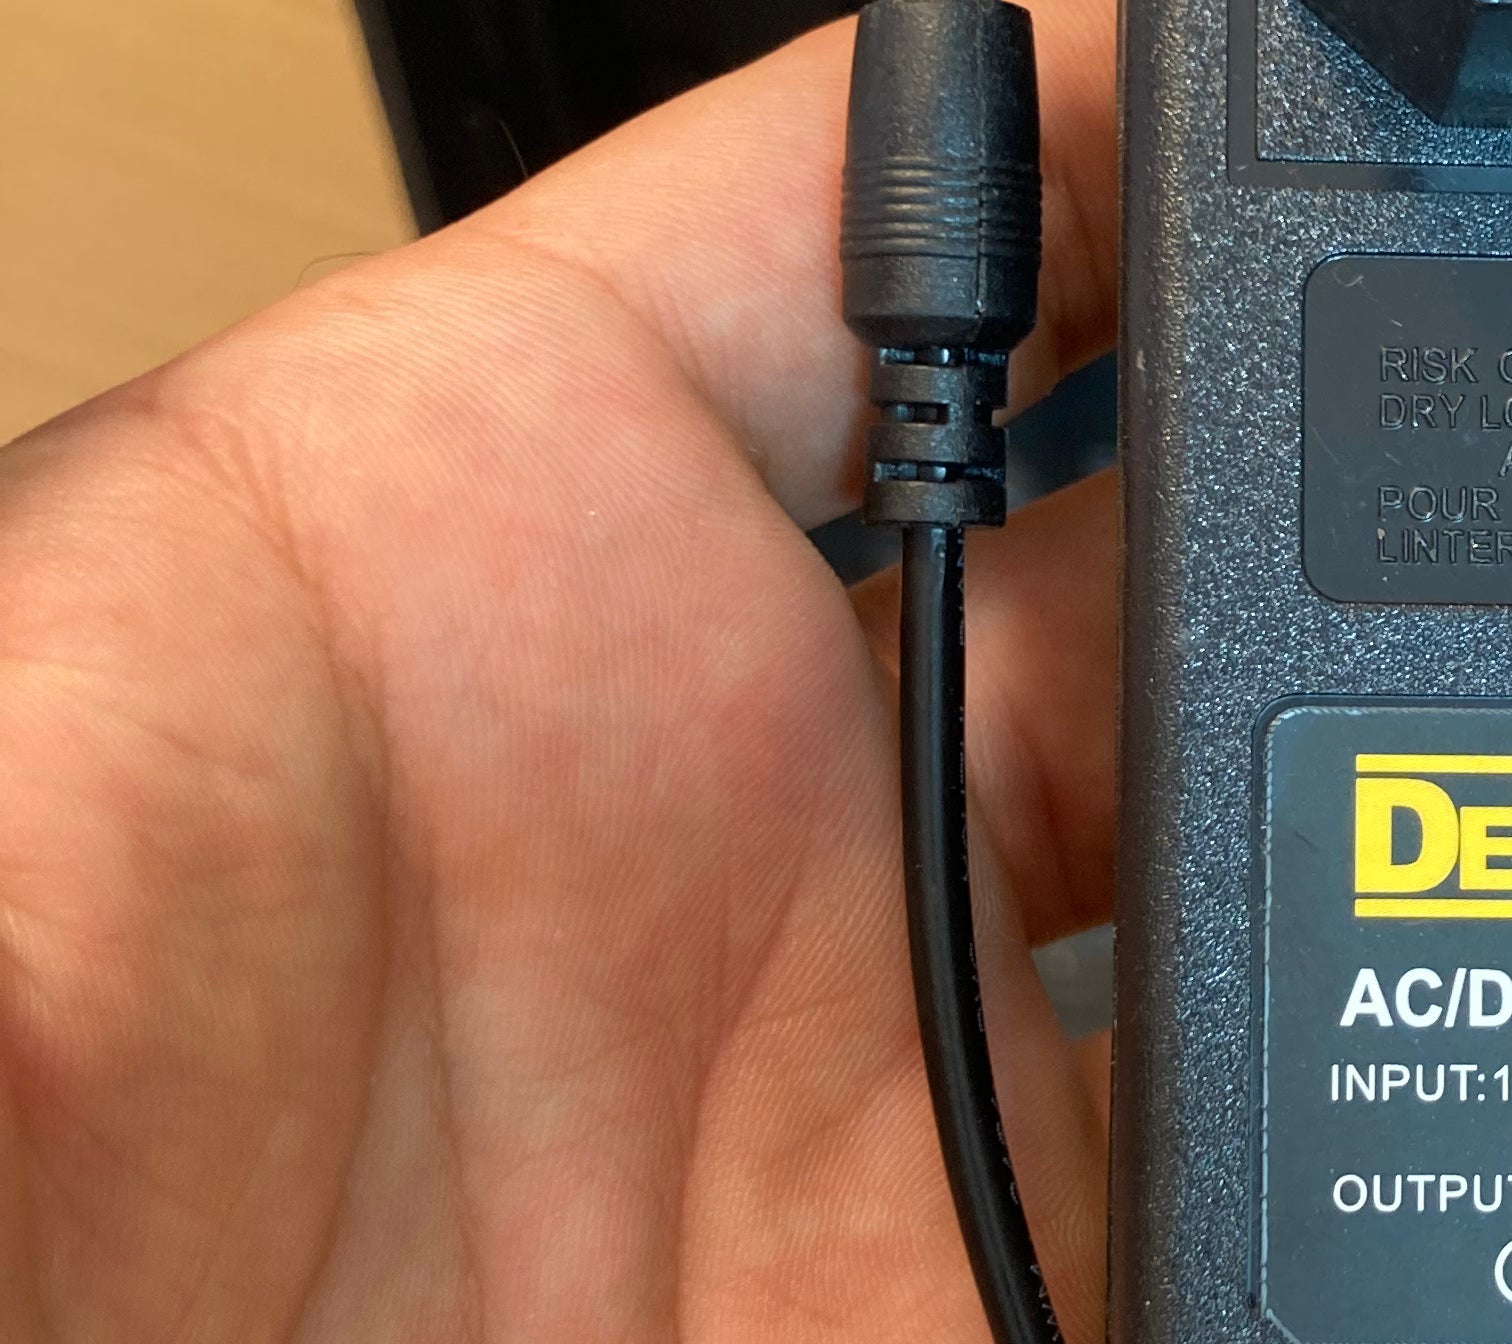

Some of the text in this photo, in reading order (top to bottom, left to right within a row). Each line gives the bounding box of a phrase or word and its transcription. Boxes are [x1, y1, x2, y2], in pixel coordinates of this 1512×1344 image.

[1379, 346, 1479, 386] RISK
[1379, 393, 1466, 433] DRY
[1377, 485, 1501, 524] POUR
